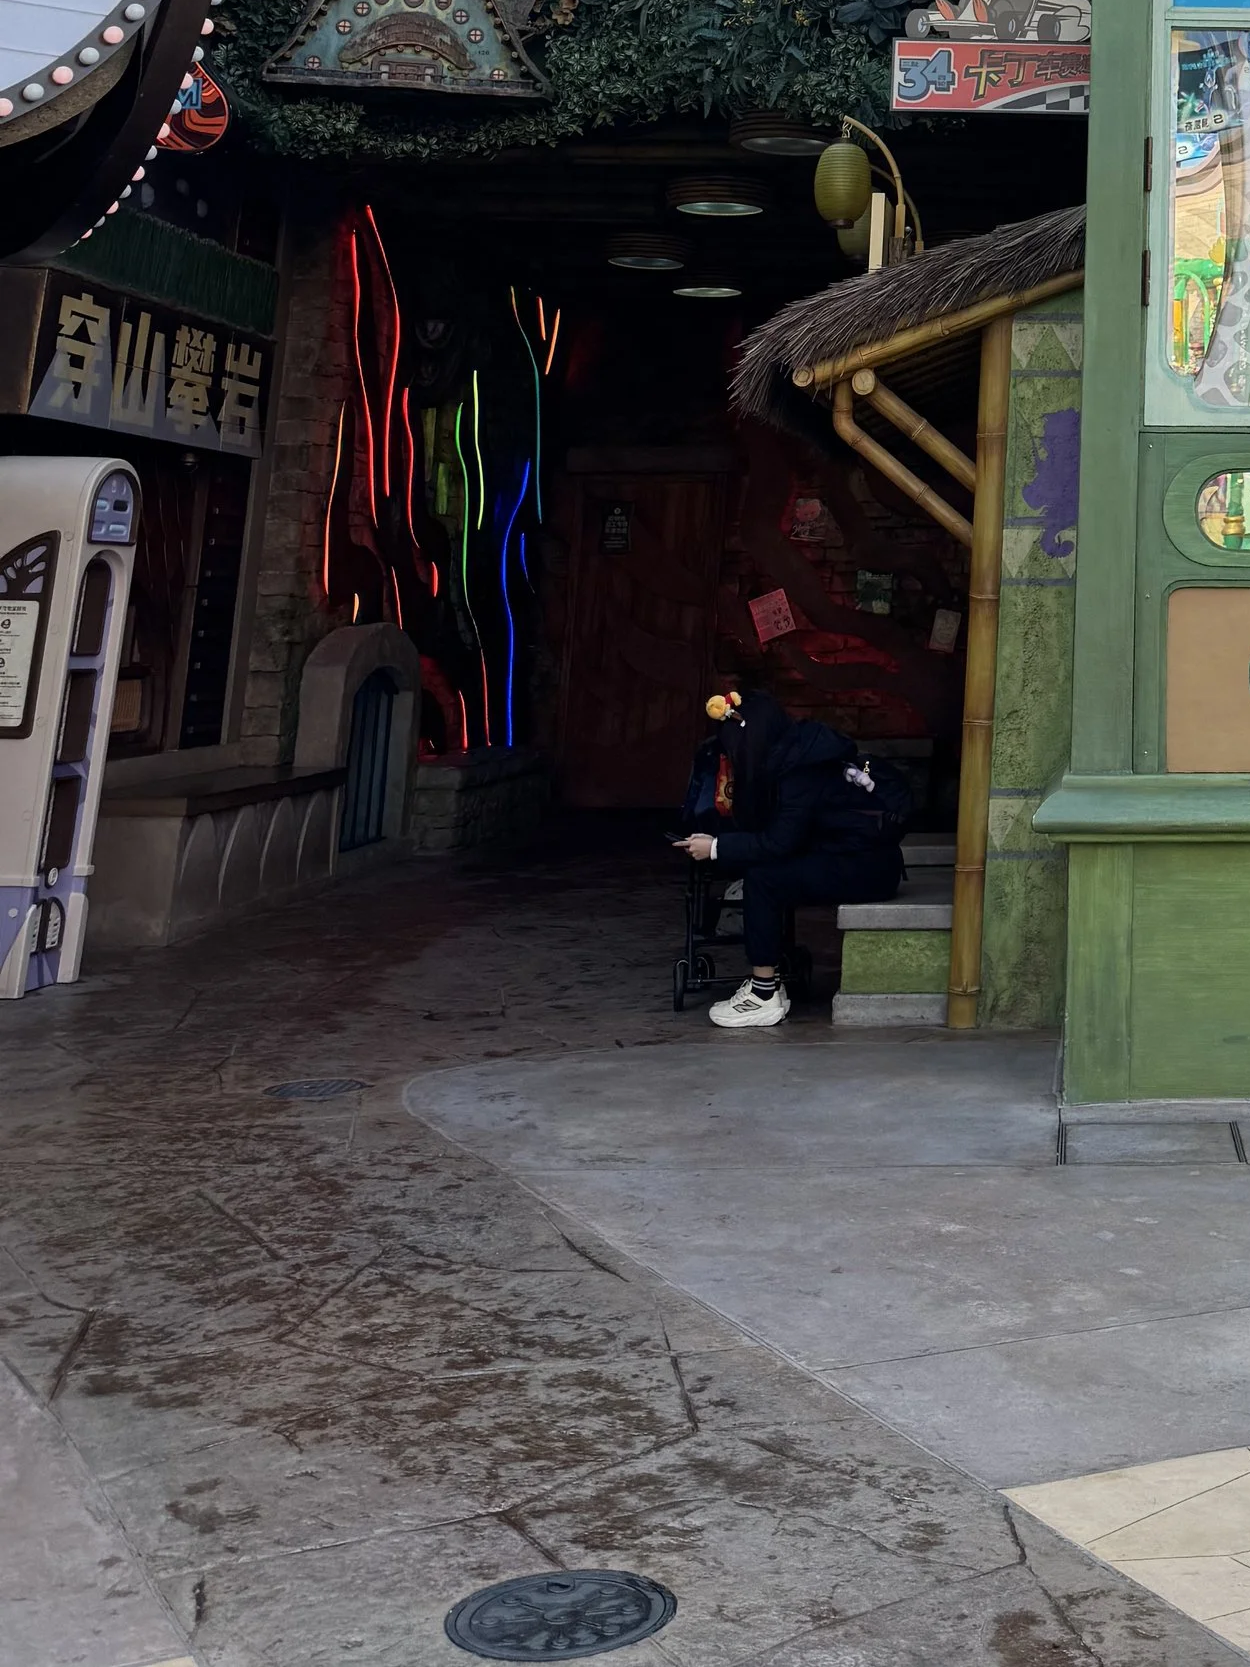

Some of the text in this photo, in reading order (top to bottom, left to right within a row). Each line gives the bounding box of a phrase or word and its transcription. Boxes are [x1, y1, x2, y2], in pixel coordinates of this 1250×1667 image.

[898, 49, 956, 101] 34
[50, 292, 262, 447] 穿山攀岩
